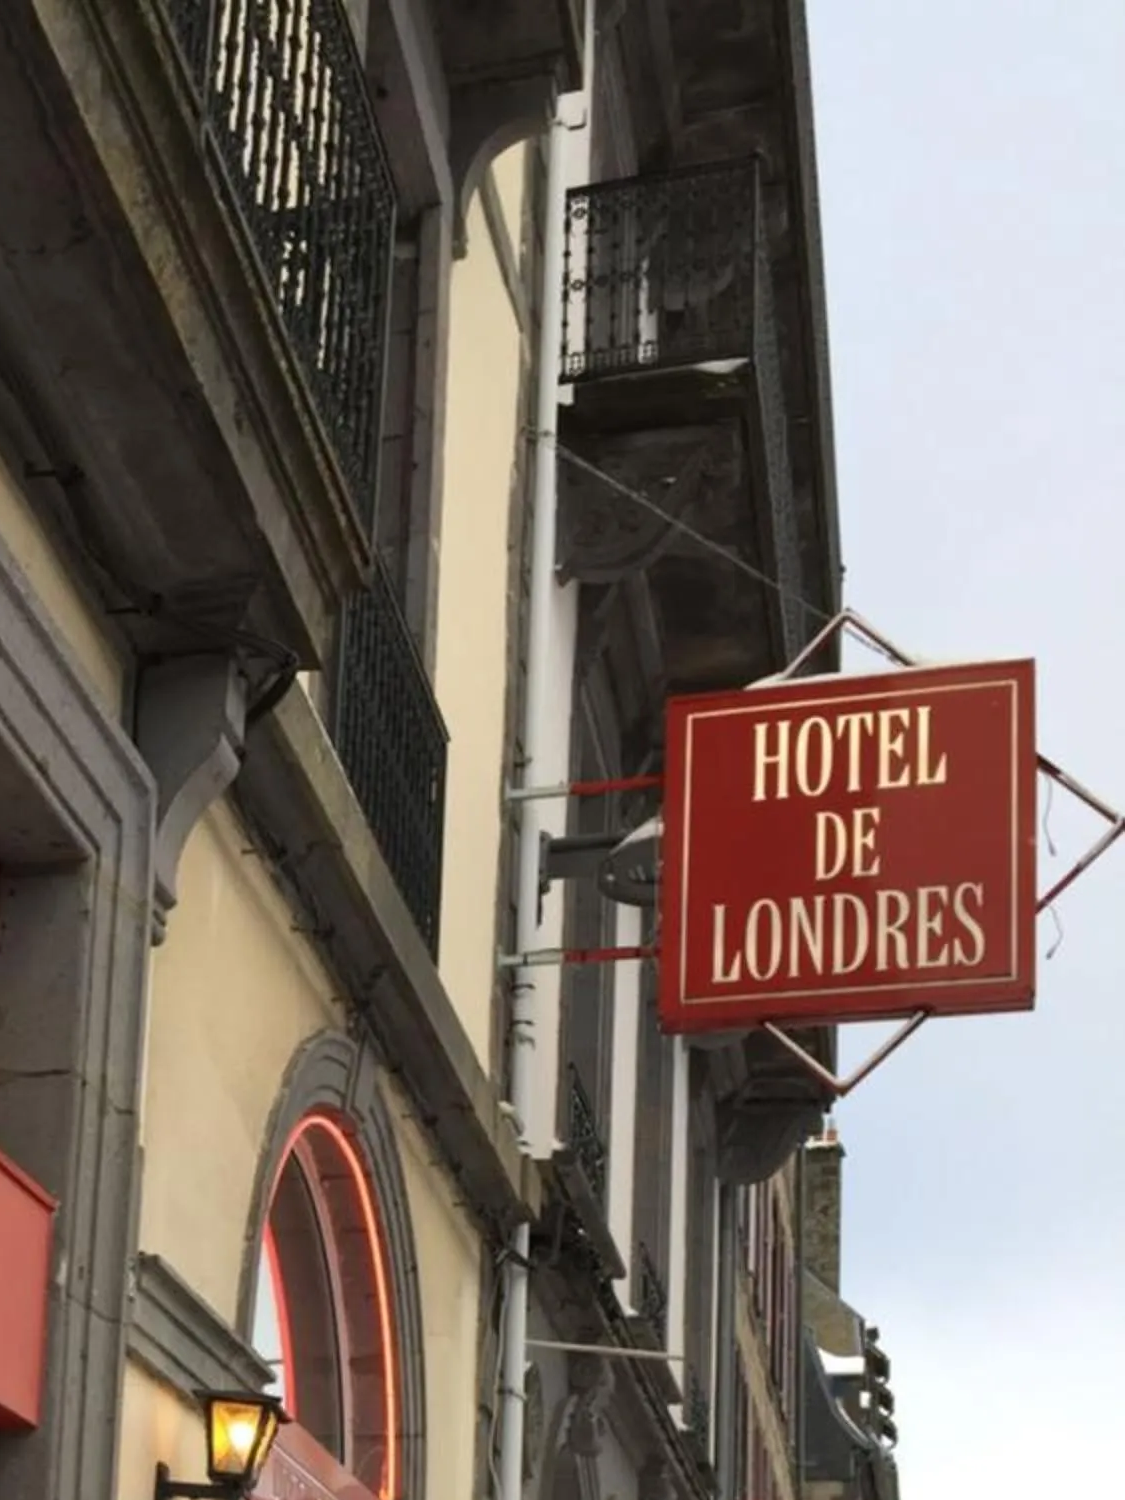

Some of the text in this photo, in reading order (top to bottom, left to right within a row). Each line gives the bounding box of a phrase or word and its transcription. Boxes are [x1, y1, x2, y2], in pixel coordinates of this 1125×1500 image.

[752, 705, 948, 802] HOTEL
[815, 807, 881, 881] DE
[711, 882, 986, 984] LONDRES
